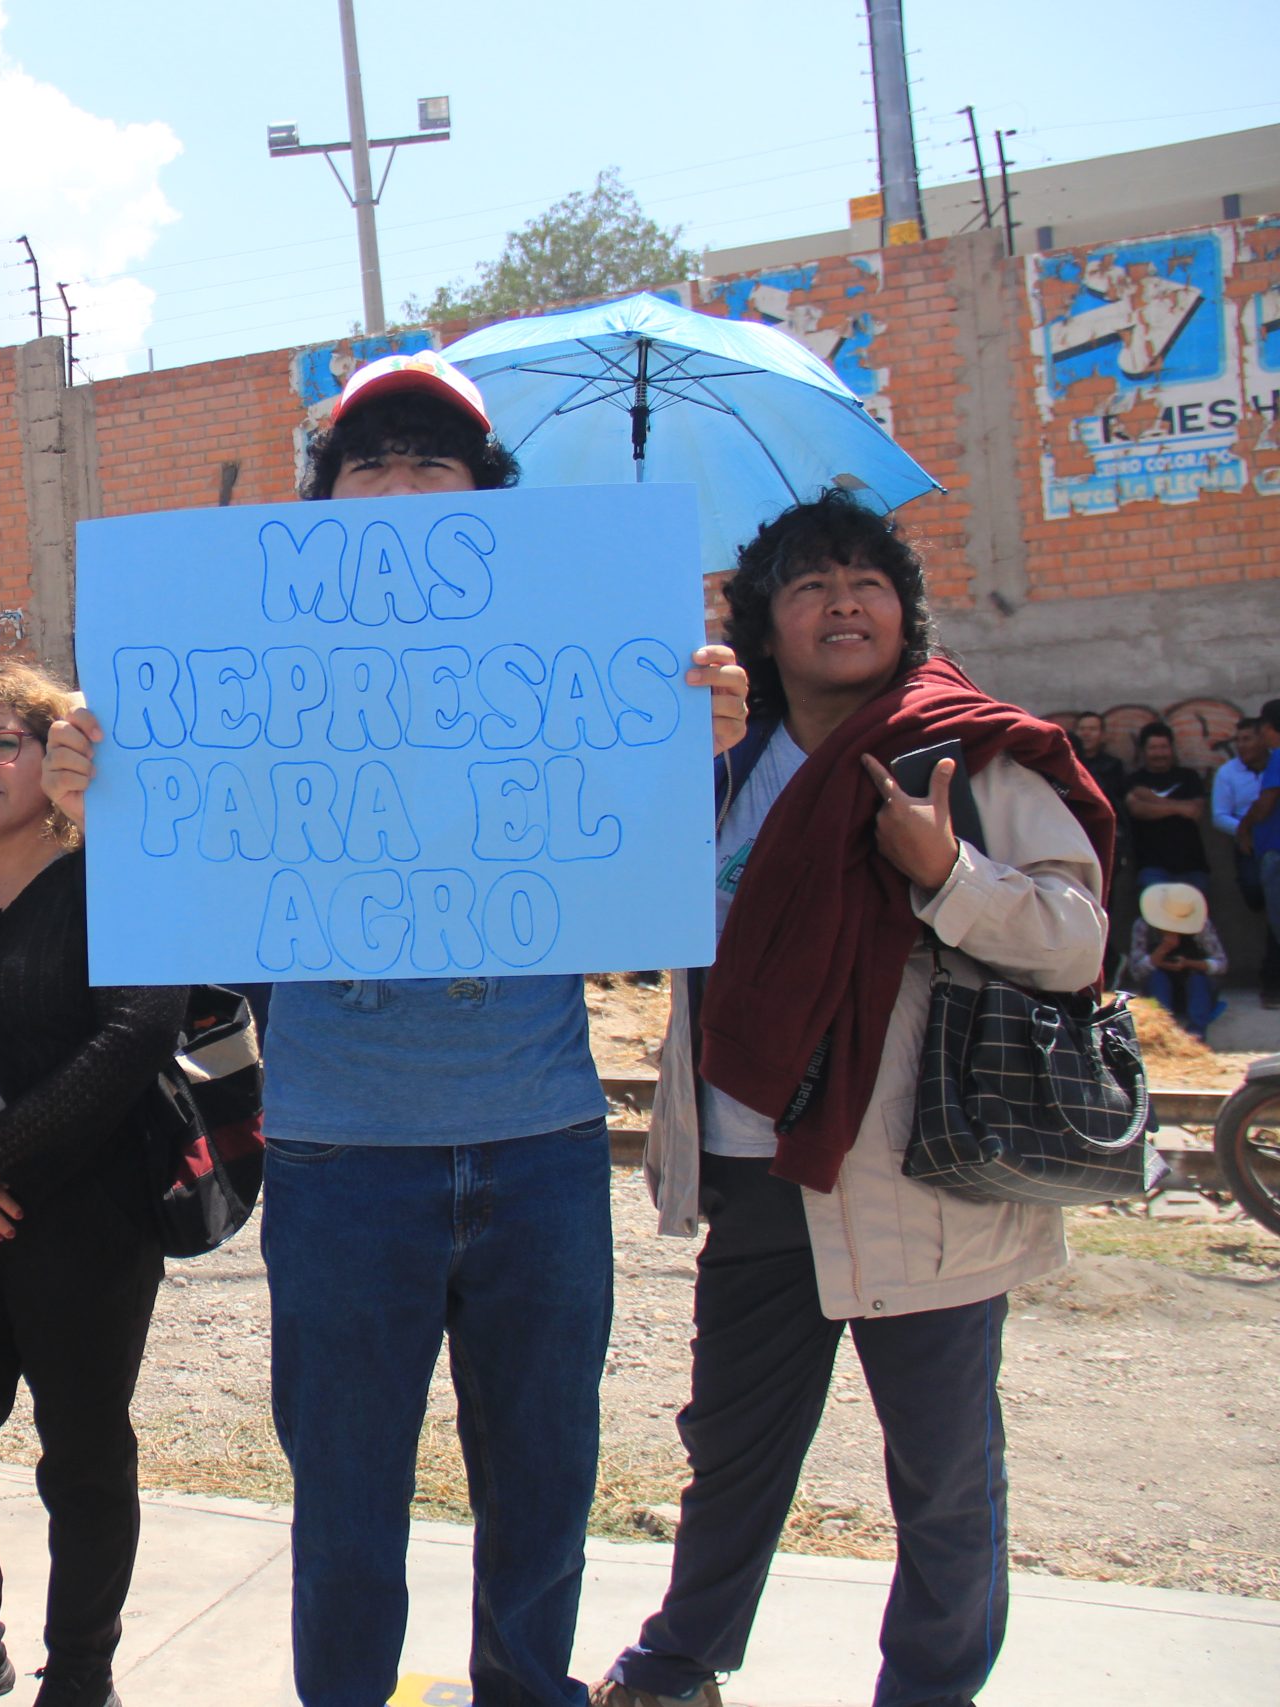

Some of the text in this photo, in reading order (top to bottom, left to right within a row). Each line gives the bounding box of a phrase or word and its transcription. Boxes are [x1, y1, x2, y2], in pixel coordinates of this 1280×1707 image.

[259, 513, 496, 627] MAS
[112, 638, 681, 751] REPRESAS
[136, 755, 622, 864] PARA EL
[256, 869, 561, 974] AGRO
